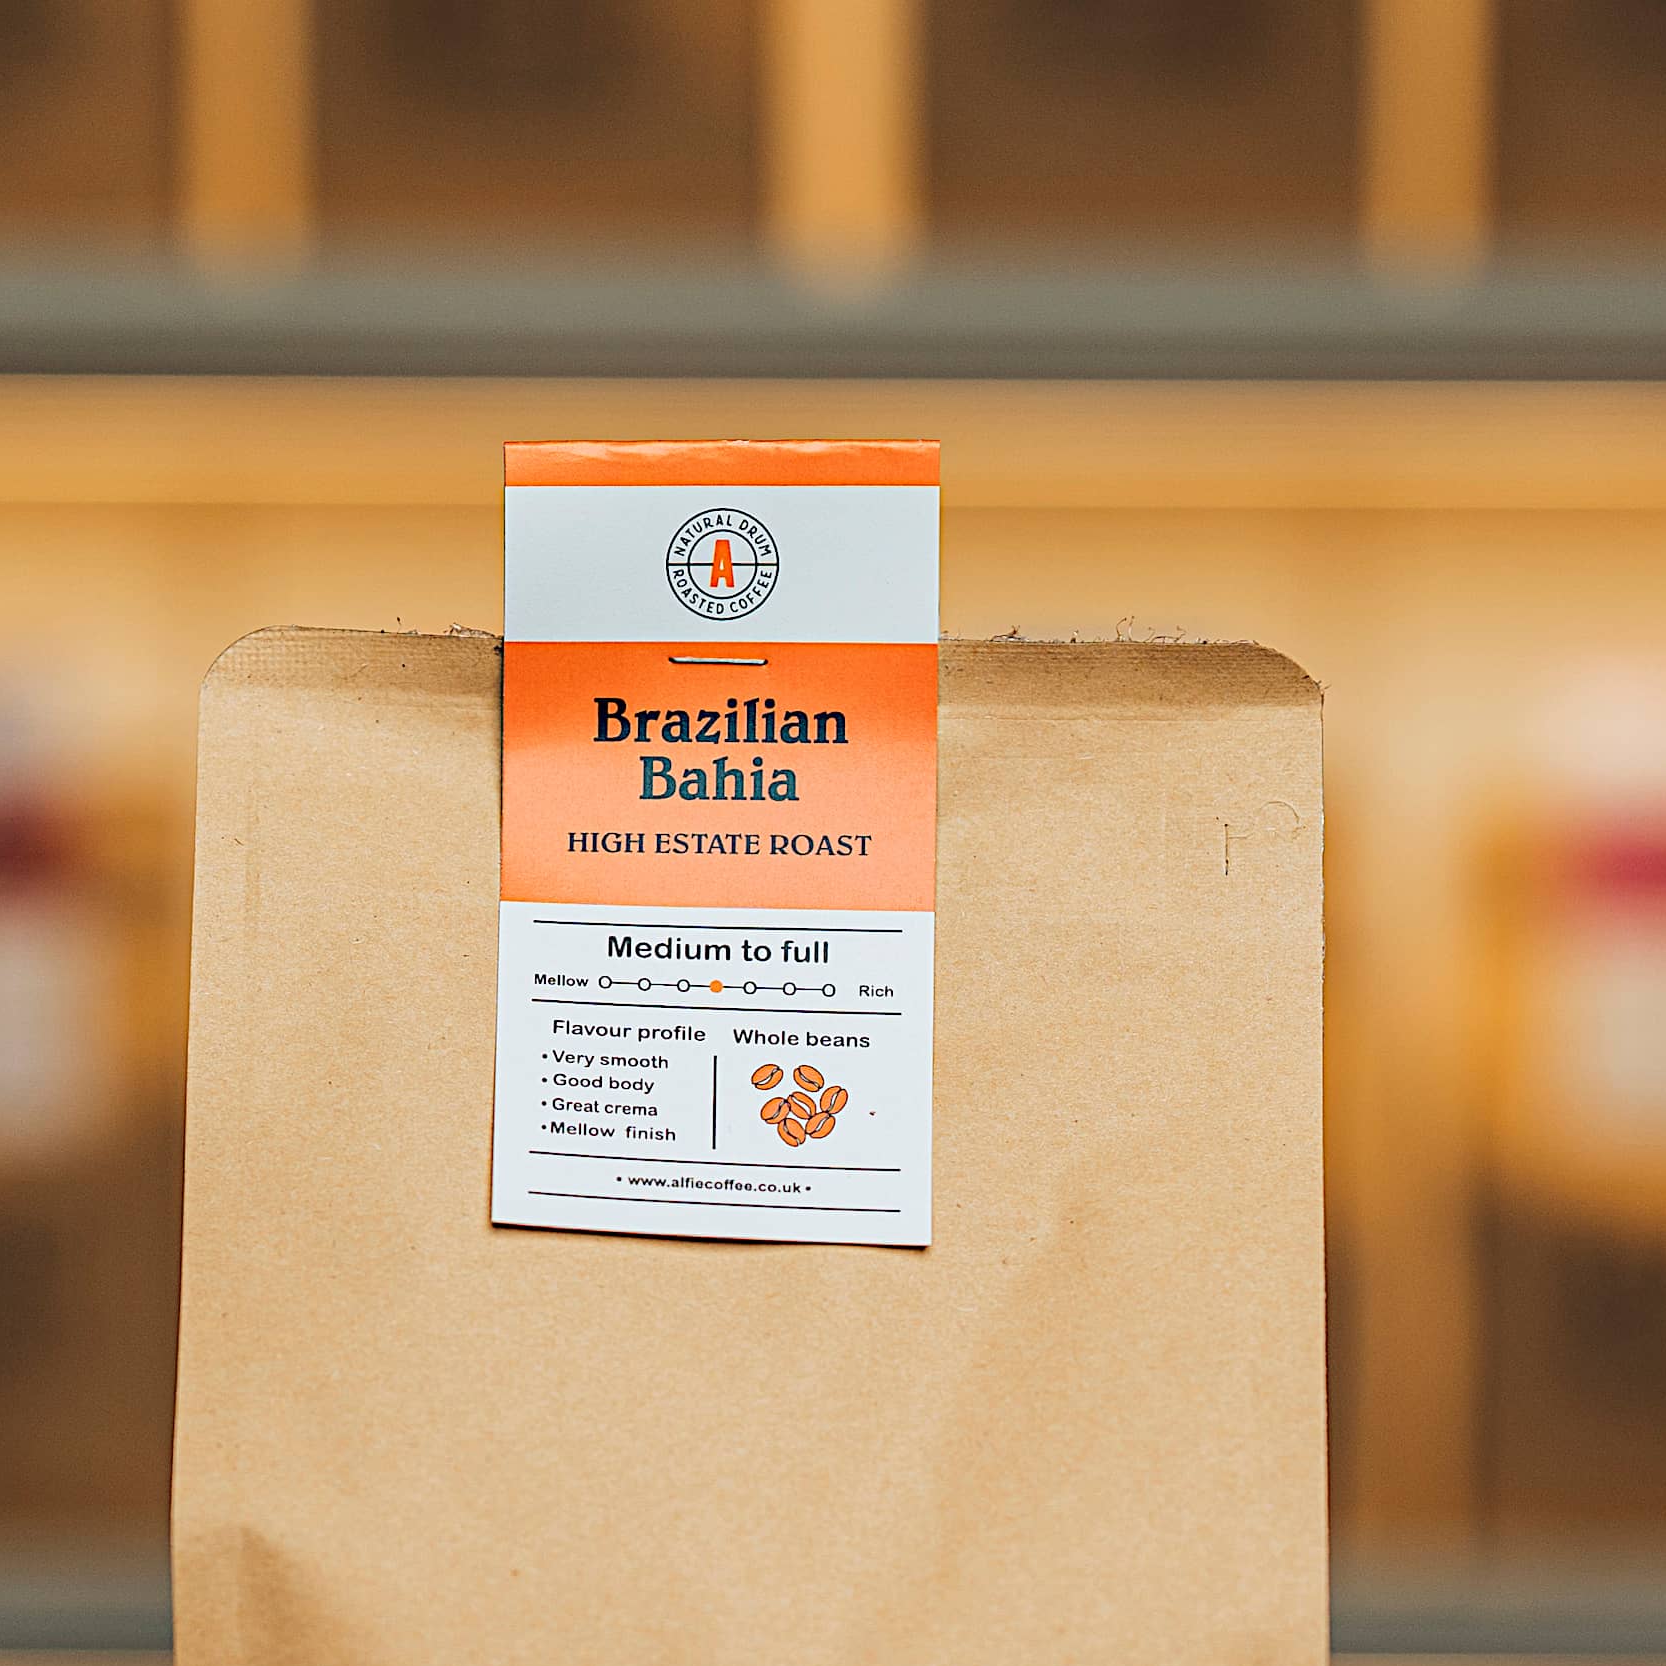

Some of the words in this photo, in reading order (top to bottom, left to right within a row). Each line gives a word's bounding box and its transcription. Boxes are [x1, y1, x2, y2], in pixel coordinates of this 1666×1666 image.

[674, 514, 732, 556] NATURAL
[739, 519, 772, 556] DRUM
[710, 539, 735, 588] A
[673, 569, 725, 614] ROASTED
[729, 570, 772, 613] COFFEE
[593, 697, 849, 744] Brazilian
[639, 755, 800, 802] Bahia
[567, 832, 646, 854] HIGH
[654, 833, 761, 855] ESTATE
[769, 834, 873, 857] ROAST
[607, 935, 732, 962] Medium
[741, 939, 772, 963] to
[780, 939, 830, 964] full
[533, 973, 589, 988] Mellow
[858, 984, 894, 998] Rich
[552, 1019, 632, 1039] Flavour
[637, 1024, 707, 1044] profile
[733, 1029, 800, 1047] Whole
[805, 1031, 871, 1049] beans
[552, 1050, 595, 1068] Very
[599, 1053, 669, 1069] smooth
[552, 1074, 603, 1090] Good
[608, 1076, 655, 1095] body
[552, 1098, 600, 1114] Great
[604, 1103, 658, 1117] crema
[550, 1122, 616, 1138] Mellow
[625, 1125, 677, 1142] finish
[628, 1176, 802, 1194] www.alfiecoffee.co.uk
